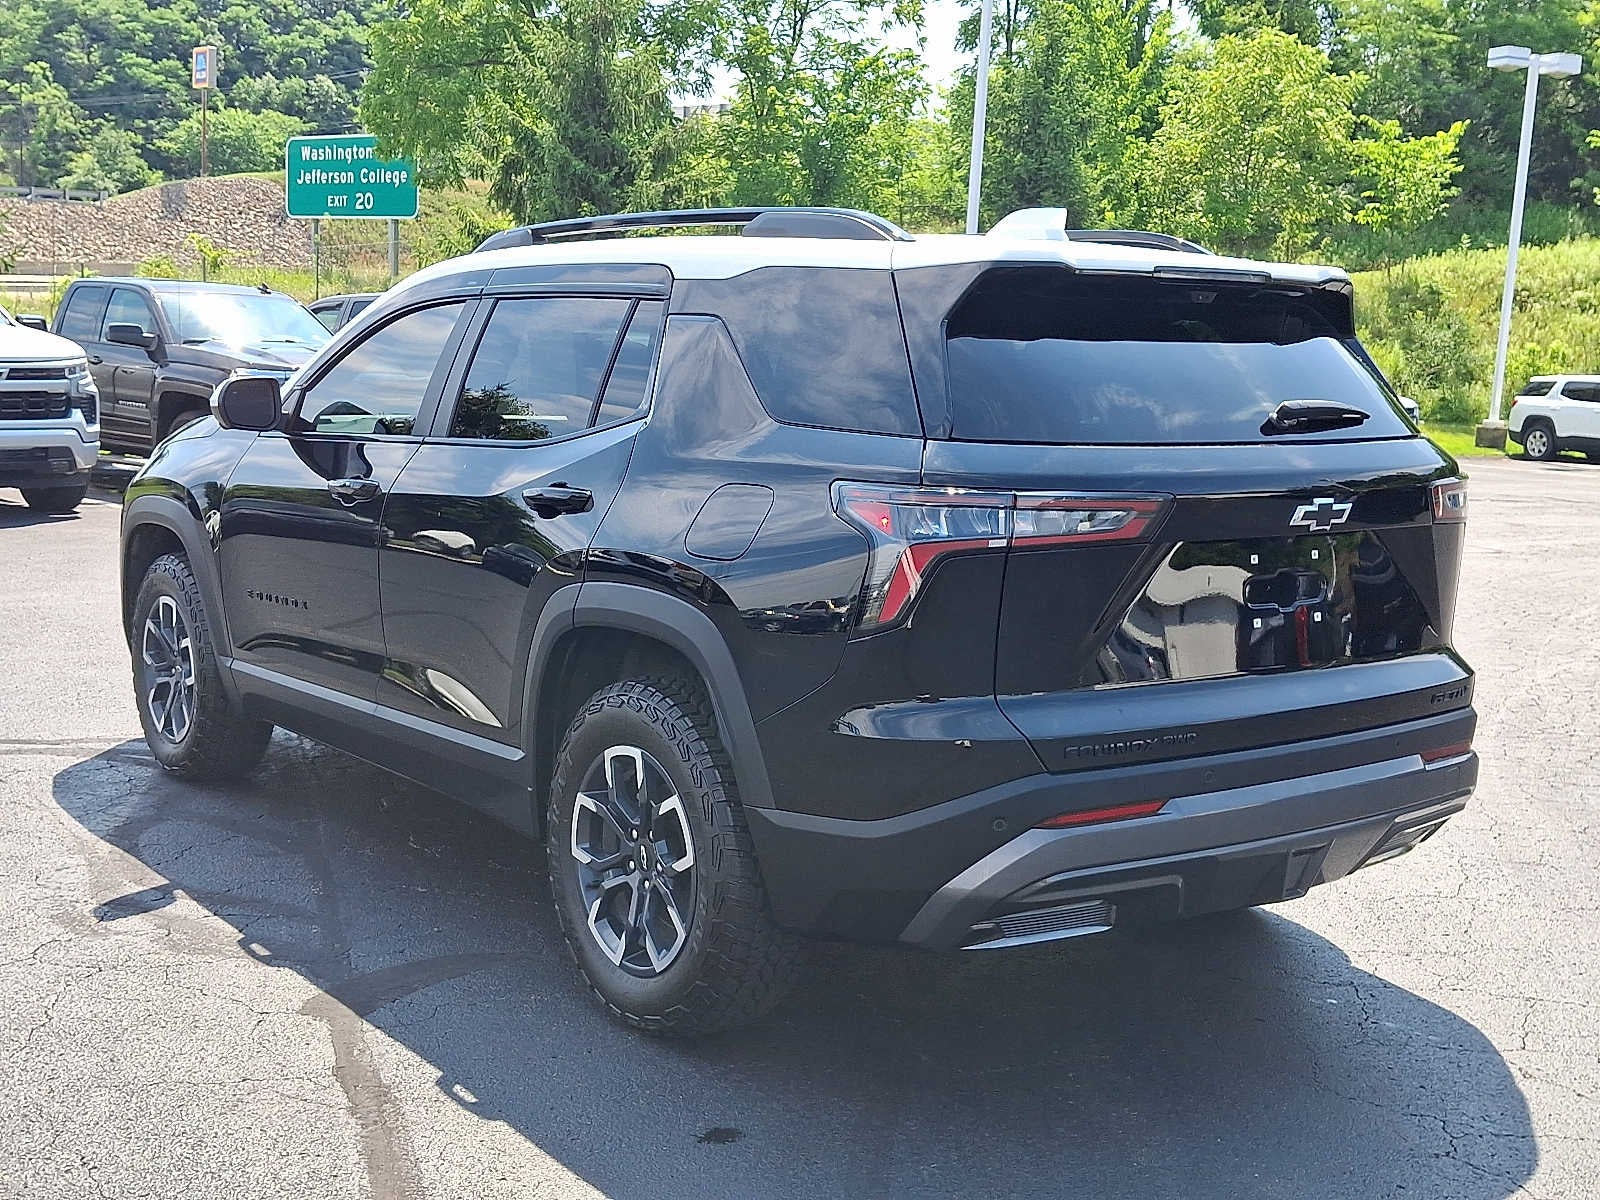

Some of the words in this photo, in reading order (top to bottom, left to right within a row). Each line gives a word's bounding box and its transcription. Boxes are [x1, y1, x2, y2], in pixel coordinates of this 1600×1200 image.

[301, 144, 373, 164] Washington
[296, 169, 354, 185] Jefferson
[360, 167, 408, 188] College
[327, 195, 348, 207] EXIT
[355, 191, 374, 210] 20
